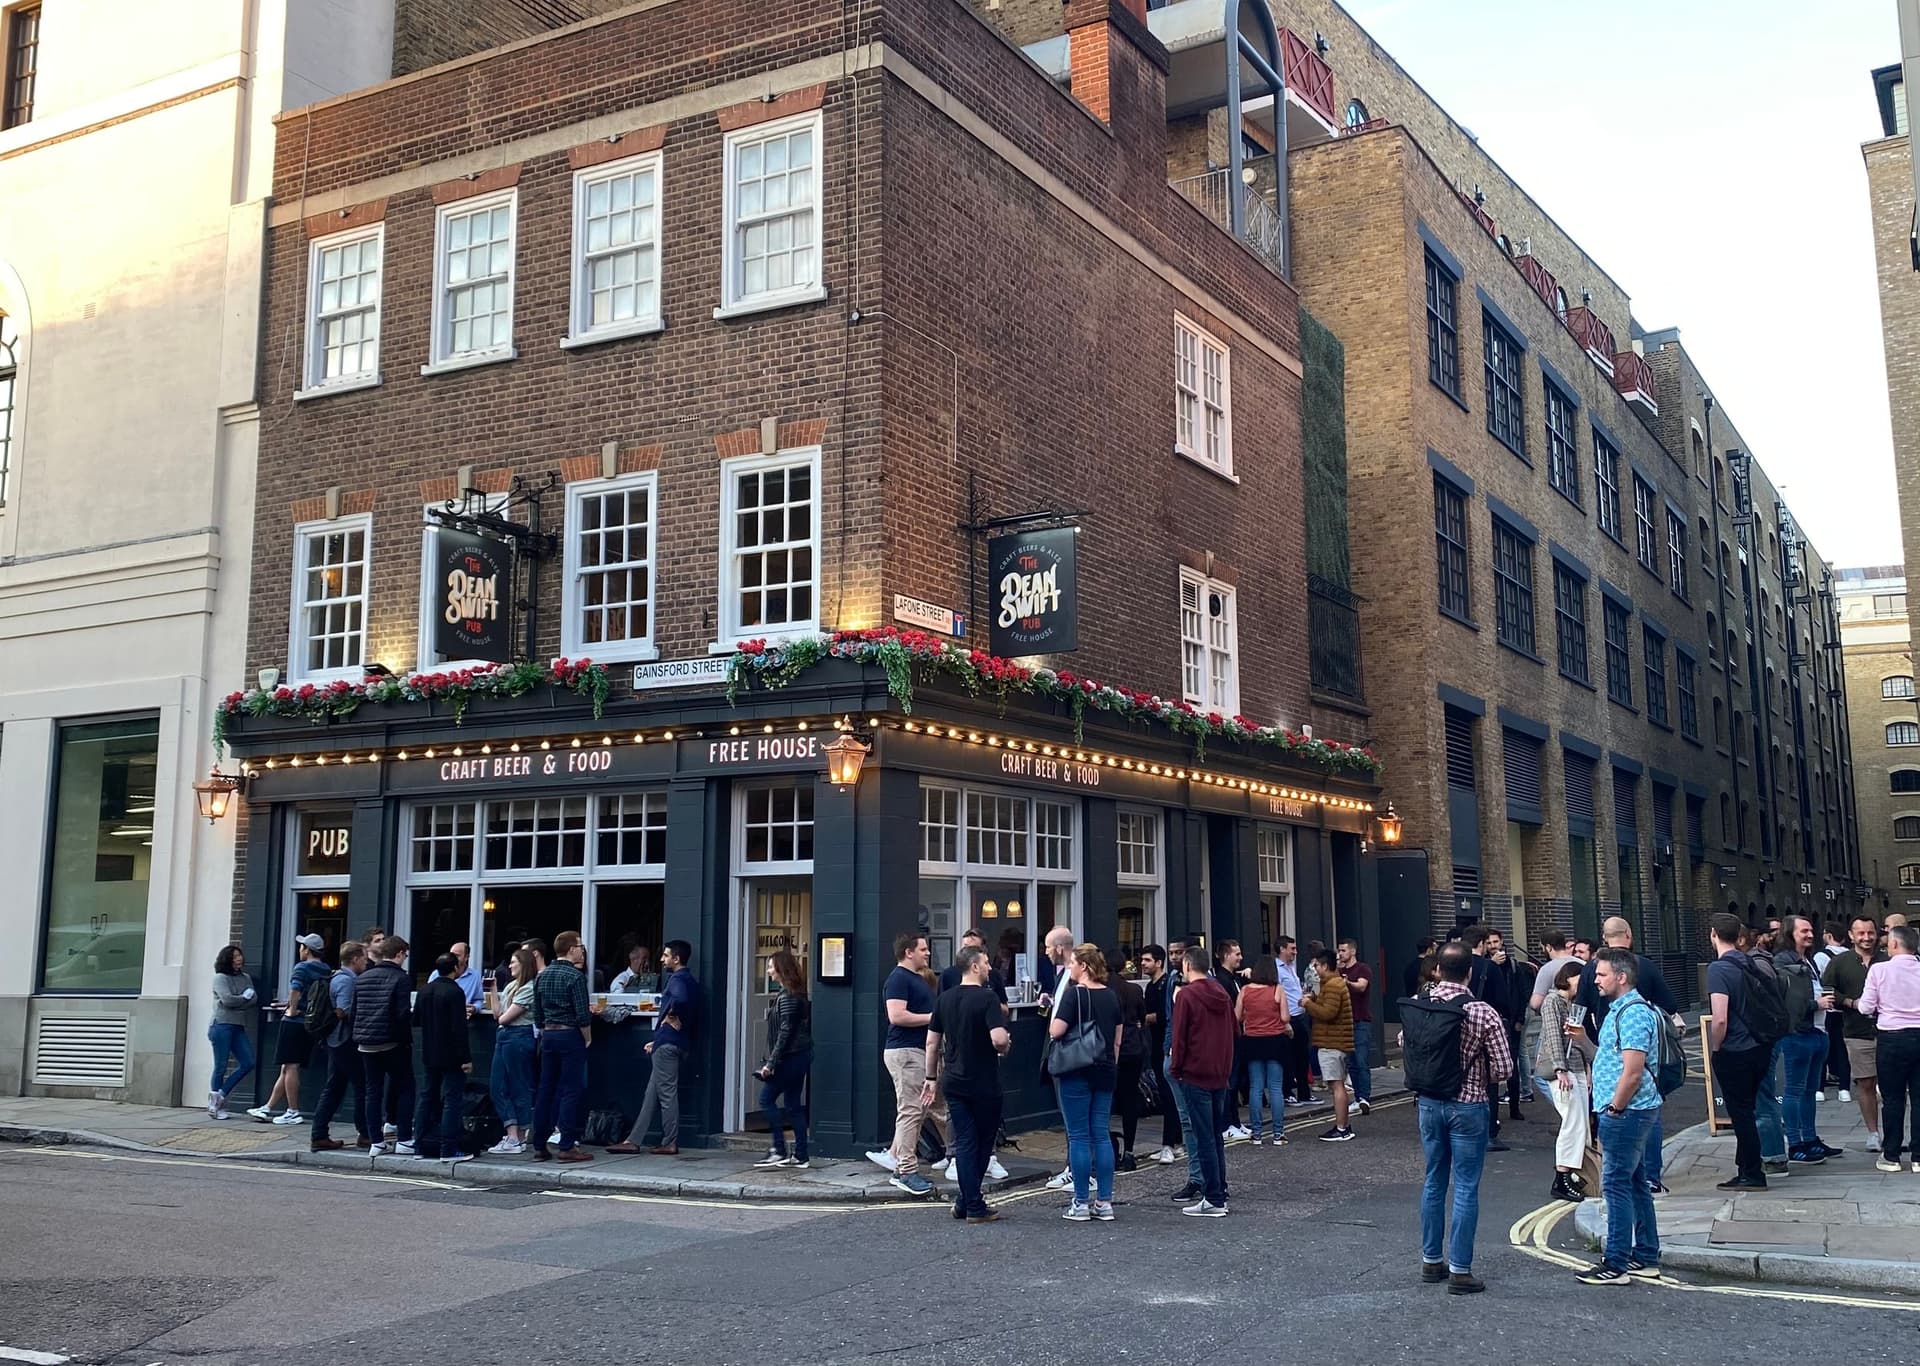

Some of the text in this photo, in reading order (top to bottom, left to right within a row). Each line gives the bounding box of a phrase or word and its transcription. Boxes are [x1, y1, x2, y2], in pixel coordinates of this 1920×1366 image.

[1000, 544, 1062, 570] CRAFT BEERS & ALES
[448, 569, 496, 600] DEAN
[1000, 563, 1057, 601] DEAN
[445, 594, 499, 625] SWIFT
[896, 597, 920, 615] LAFONE
[922, 605, 944, 621] STREET
[998, 588, 1062, 629] SWIFT
[465, 620, 482, 633] PUB
[1010, 627, 1053, 642] FREE HOUSE
[1022, 618, 1041, 630] PUB
[635, 660, 728, 679] GAINSFORD STREET
[709, 737, 817, 763] FREE HOUSE
[440, 751, 611, 781] CRAFT BEER & FOOD
[1001, 753, 1099, 786] CRAFT BEER & FOOD
[1270, 799, 1283, 815] FREE
[308, 828, 349, 857] PUB
[1800, 883, 1812, 894] 51
[1825, 889, 1835, 900] 51
